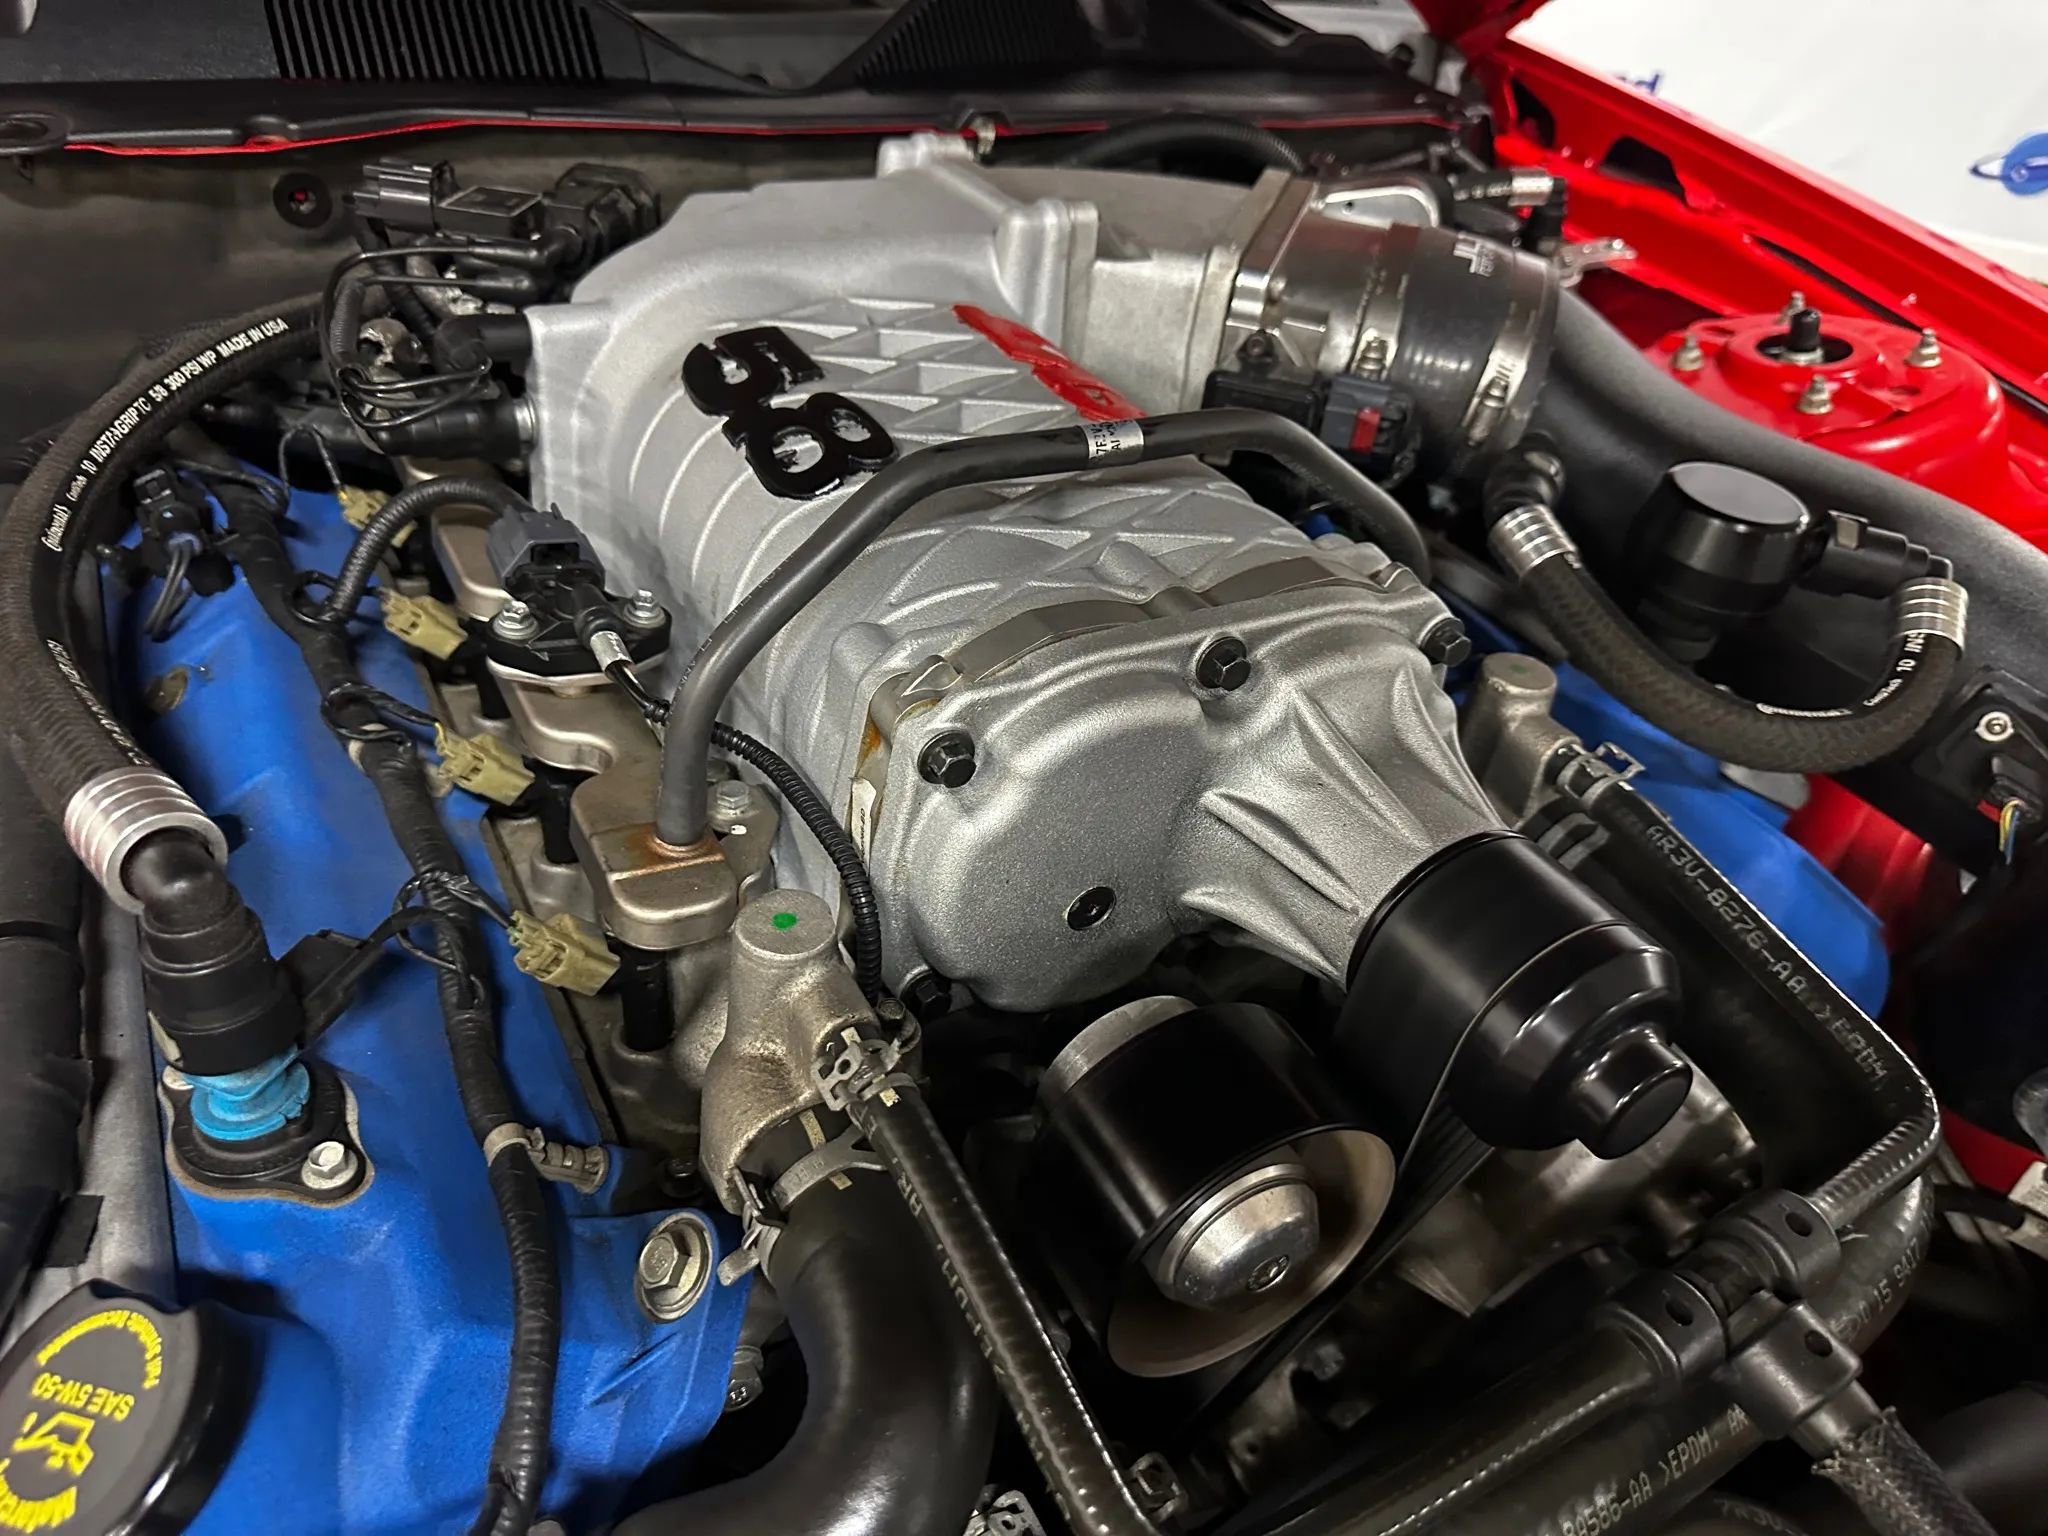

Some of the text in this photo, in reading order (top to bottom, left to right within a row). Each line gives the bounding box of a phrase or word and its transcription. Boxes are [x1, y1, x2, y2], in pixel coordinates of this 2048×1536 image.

[80, 460, 98, 475] 10
[148, 384, 169, 402] 5/8
[163, 371, 187, 391] 300
[179, 359, 204, 379] PSI
[196, 350, 218, 369] WP
[216, 332, 253, 358] MADE
[247, 327, 266, 343] IN
[260, 317, 290, 337] USA
[1896, 659, 1916, 671] 10
[31, 1372, 135, 1421] SAE 5W-50
